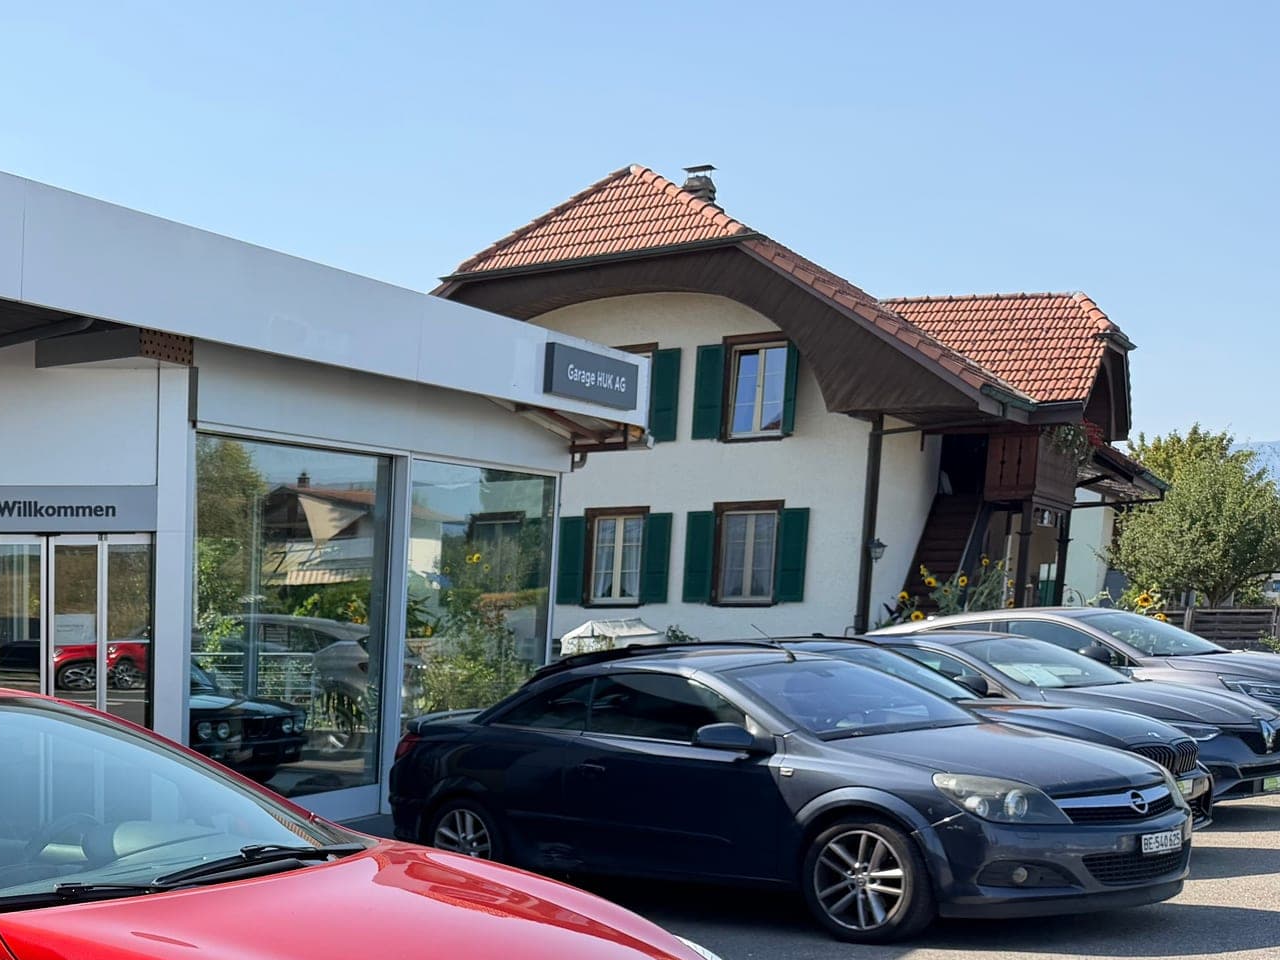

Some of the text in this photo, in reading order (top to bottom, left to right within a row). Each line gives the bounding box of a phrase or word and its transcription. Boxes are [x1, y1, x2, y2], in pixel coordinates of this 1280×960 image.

[567, 363, 626, 393] Garage HUK AG
